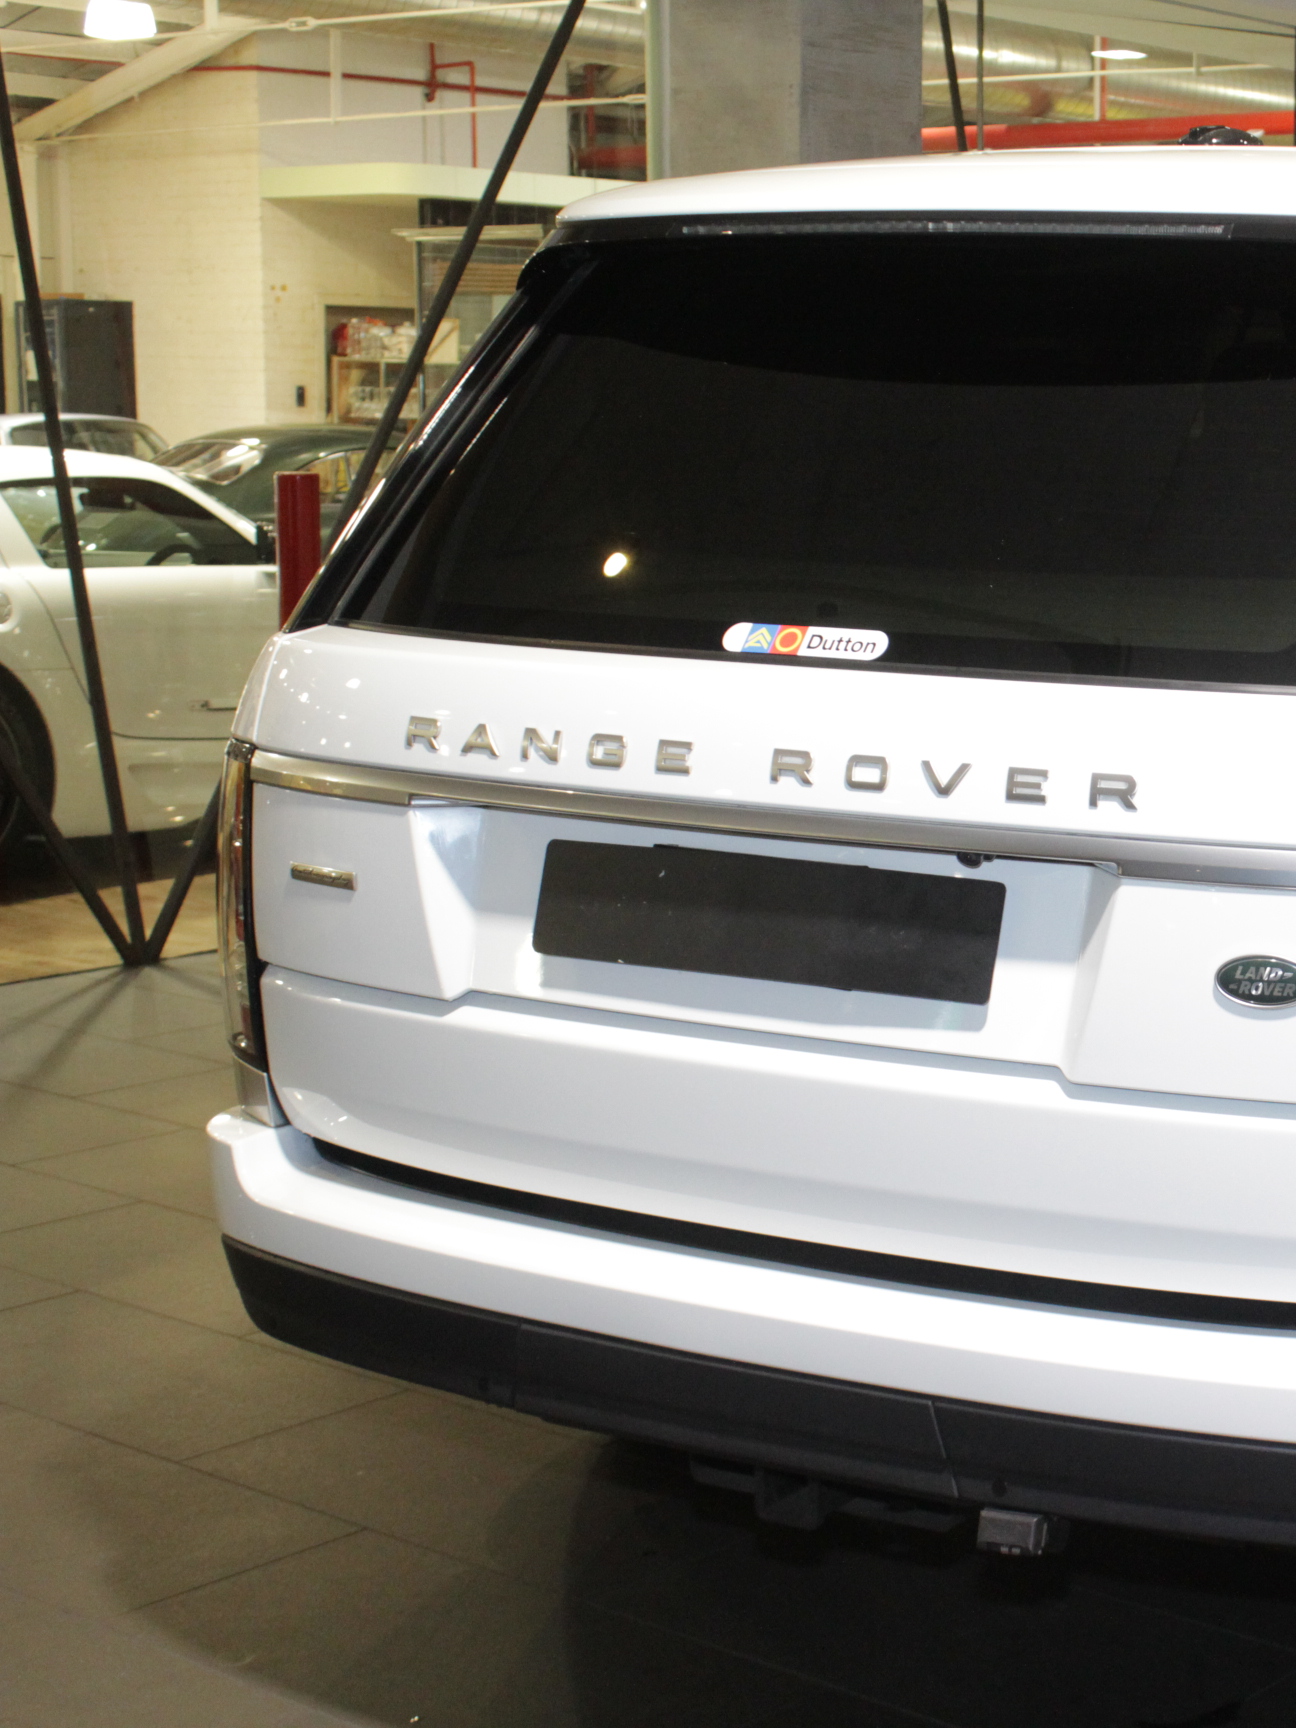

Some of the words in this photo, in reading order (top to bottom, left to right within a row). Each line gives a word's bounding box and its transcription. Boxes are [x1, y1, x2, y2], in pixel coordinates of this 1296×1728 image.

[806, 633, 877, 654] Dutton
[404, 715, 693, 776] RANGE
[770, 747, 1139, 812] ROVER
[1235, 965, 1285, 981] LAND
[1238, 981, 1296, 997] ROVER
